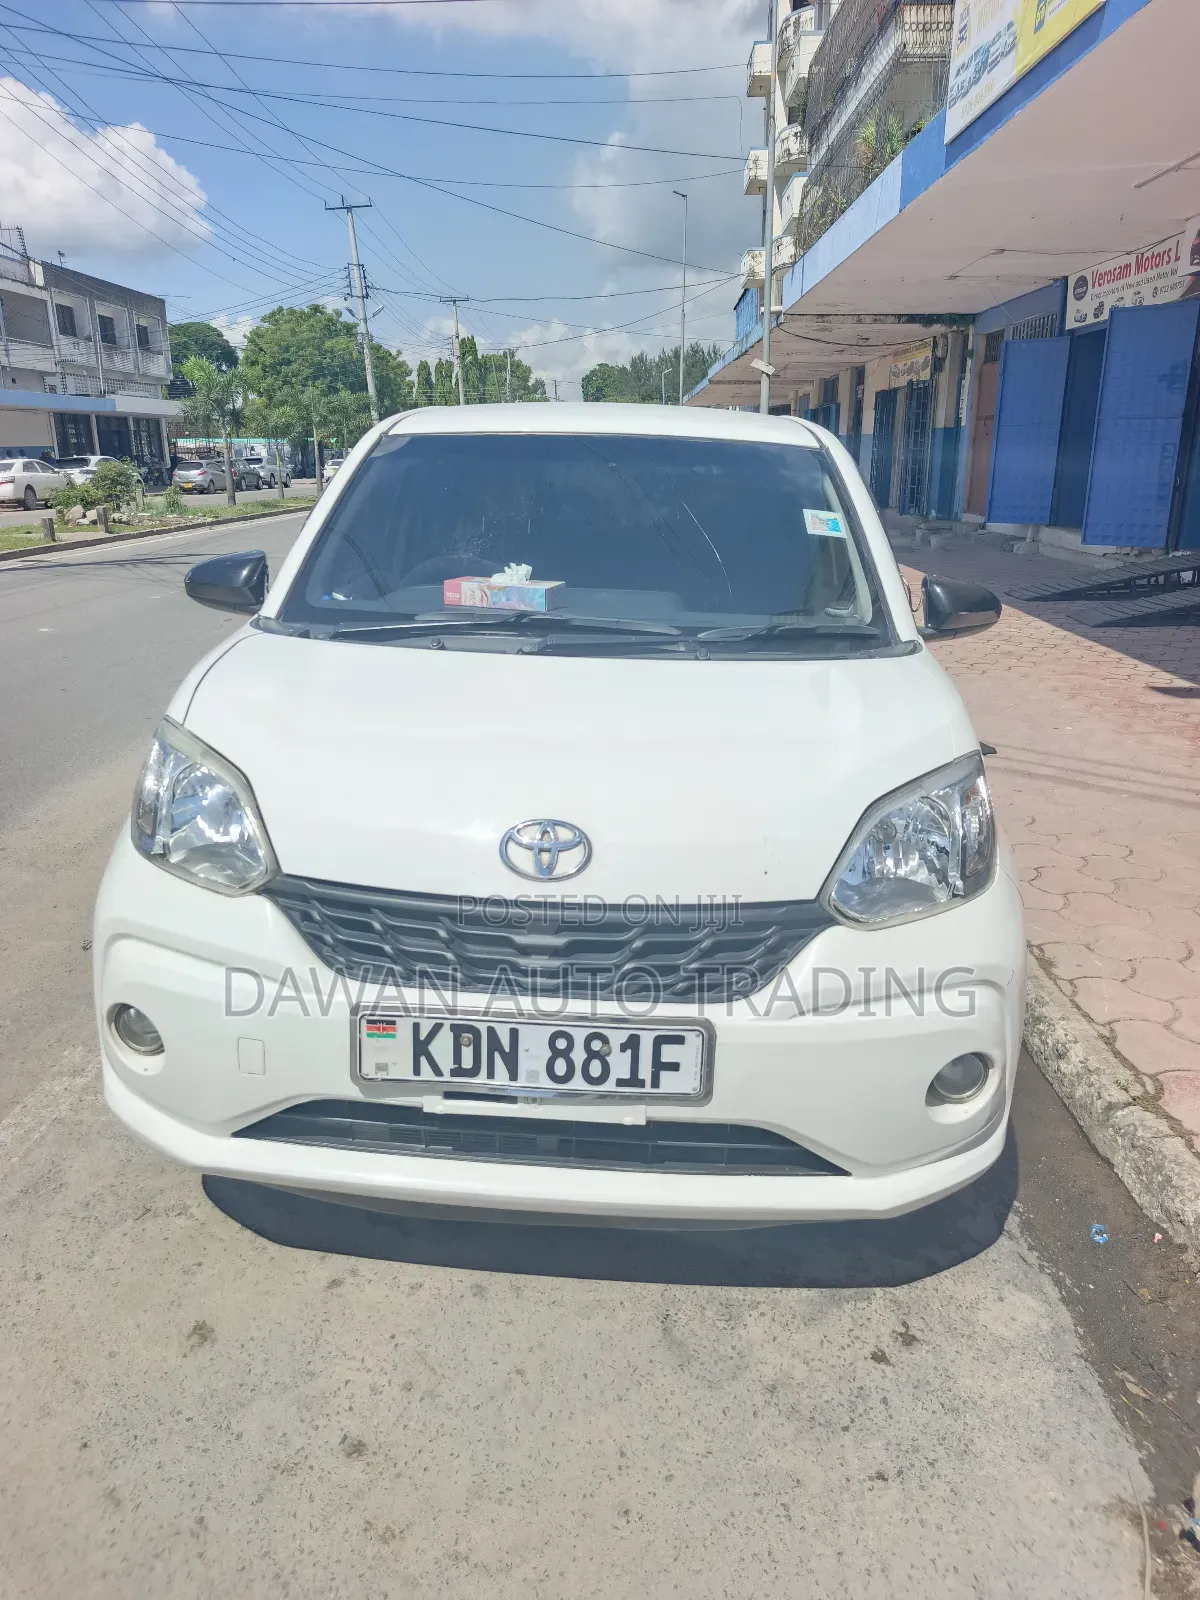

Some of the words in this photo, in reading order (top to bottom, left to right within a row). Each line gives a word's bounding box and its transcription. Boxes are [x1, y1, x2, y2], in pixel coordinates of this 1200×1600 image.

[1091, 261, 1132, 290] Verosam
[1134, 247, 1173, 276] Motors
[1125, 281, 1135, 291] New
[1143, 275, 1156, 285] Used
[1155, 271, 1170, 282] Motor
[412, 1021, 519, 1082] KDN
[546, 1029, 686, 1089] 881F
